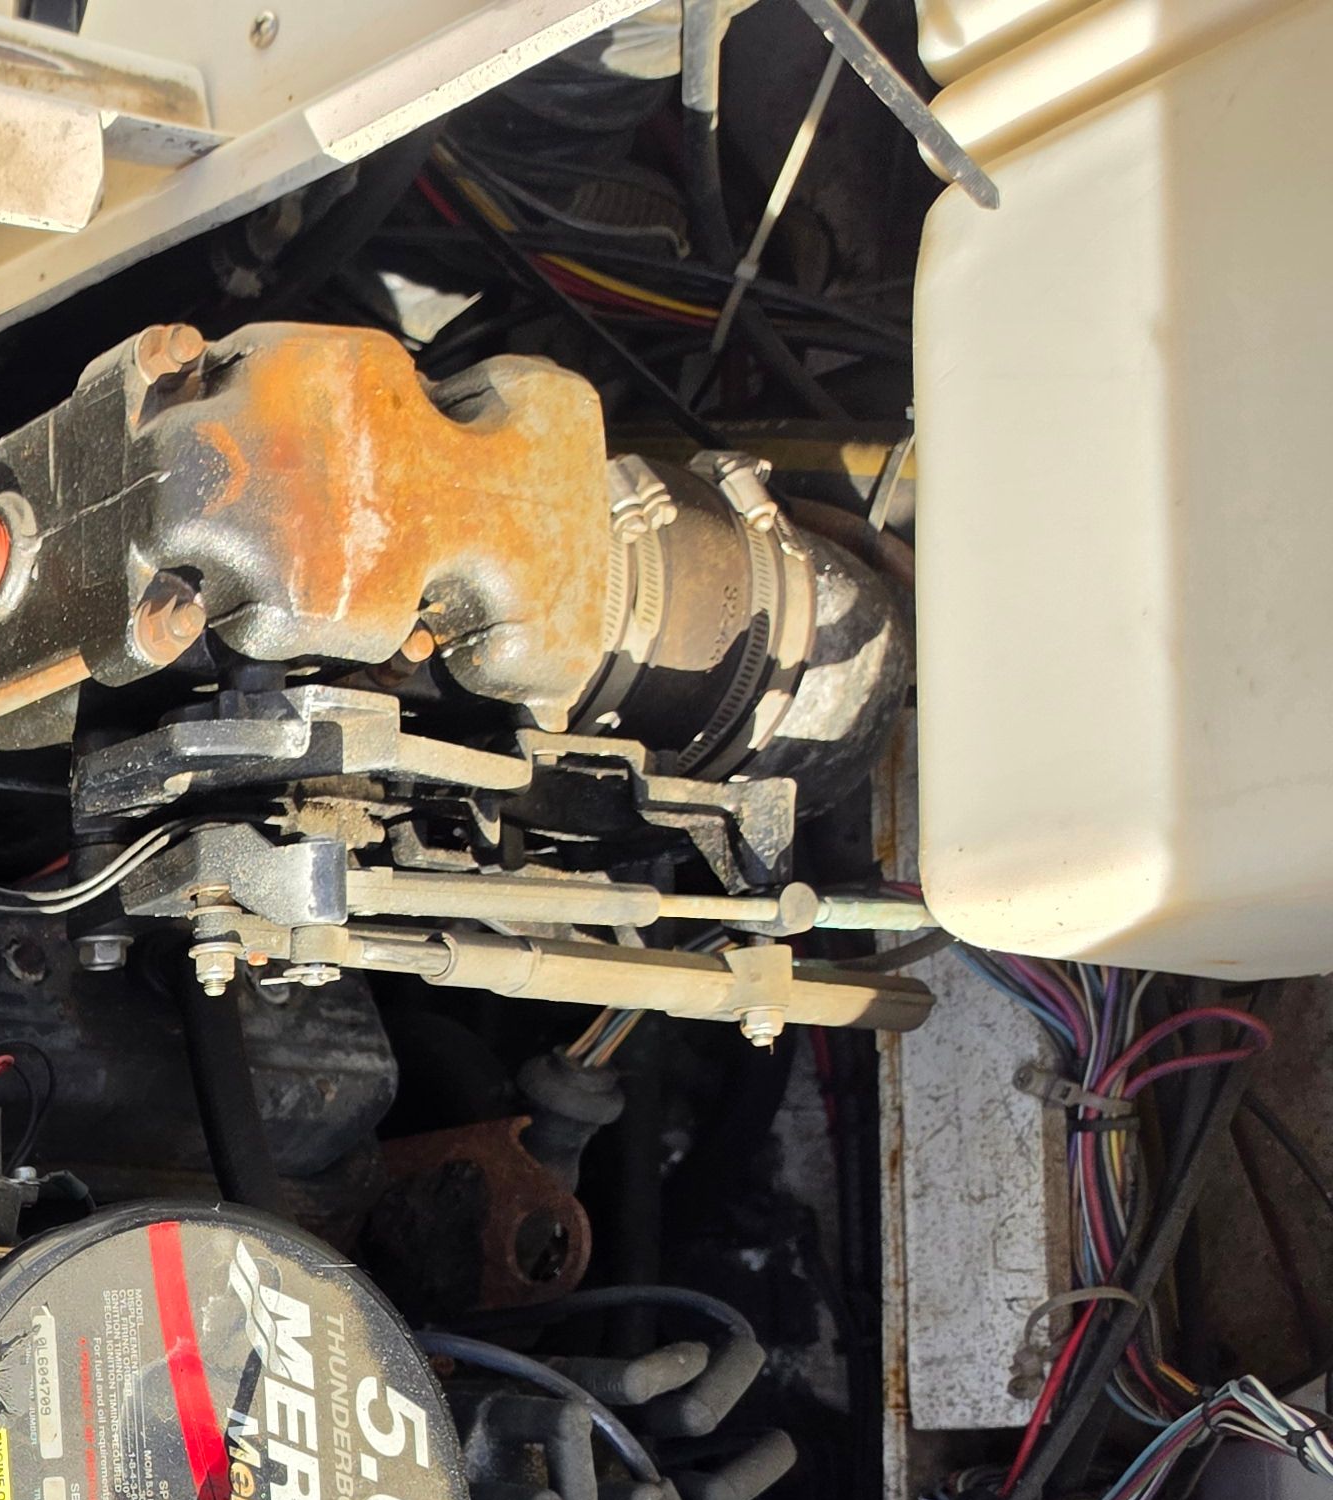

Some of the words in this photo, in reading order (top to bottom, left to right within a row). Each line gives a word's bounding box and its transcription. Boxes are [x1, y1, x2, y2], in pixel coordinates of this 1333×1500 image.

[102, 1290, 112, 1336] SPECIAL
[111, 1290, 121, 1339] IGNITION
[135, 1288, 145, 1326] MODEL
[93, 1337, 102, 1356] For
[120, 1316, 130, 1354] FIRING
[127, 1288, 139, 1376] DISPLACEMENT
[94, 1359, 103, 1382] fuel
[106, 1339, 116, 1389] IGNITION
[114, 1342, 124, 1382] TIMING
[123, 1359, 133, 1397] ORDER
[96, 1384, 105, 1406] and
[109, 1392, 119, 1432] TIMING
[97, 1409, 106, 1424] oil
[98, 1426, 110, 1500] requirements
[143, 1450, 153, 1479] MCM
